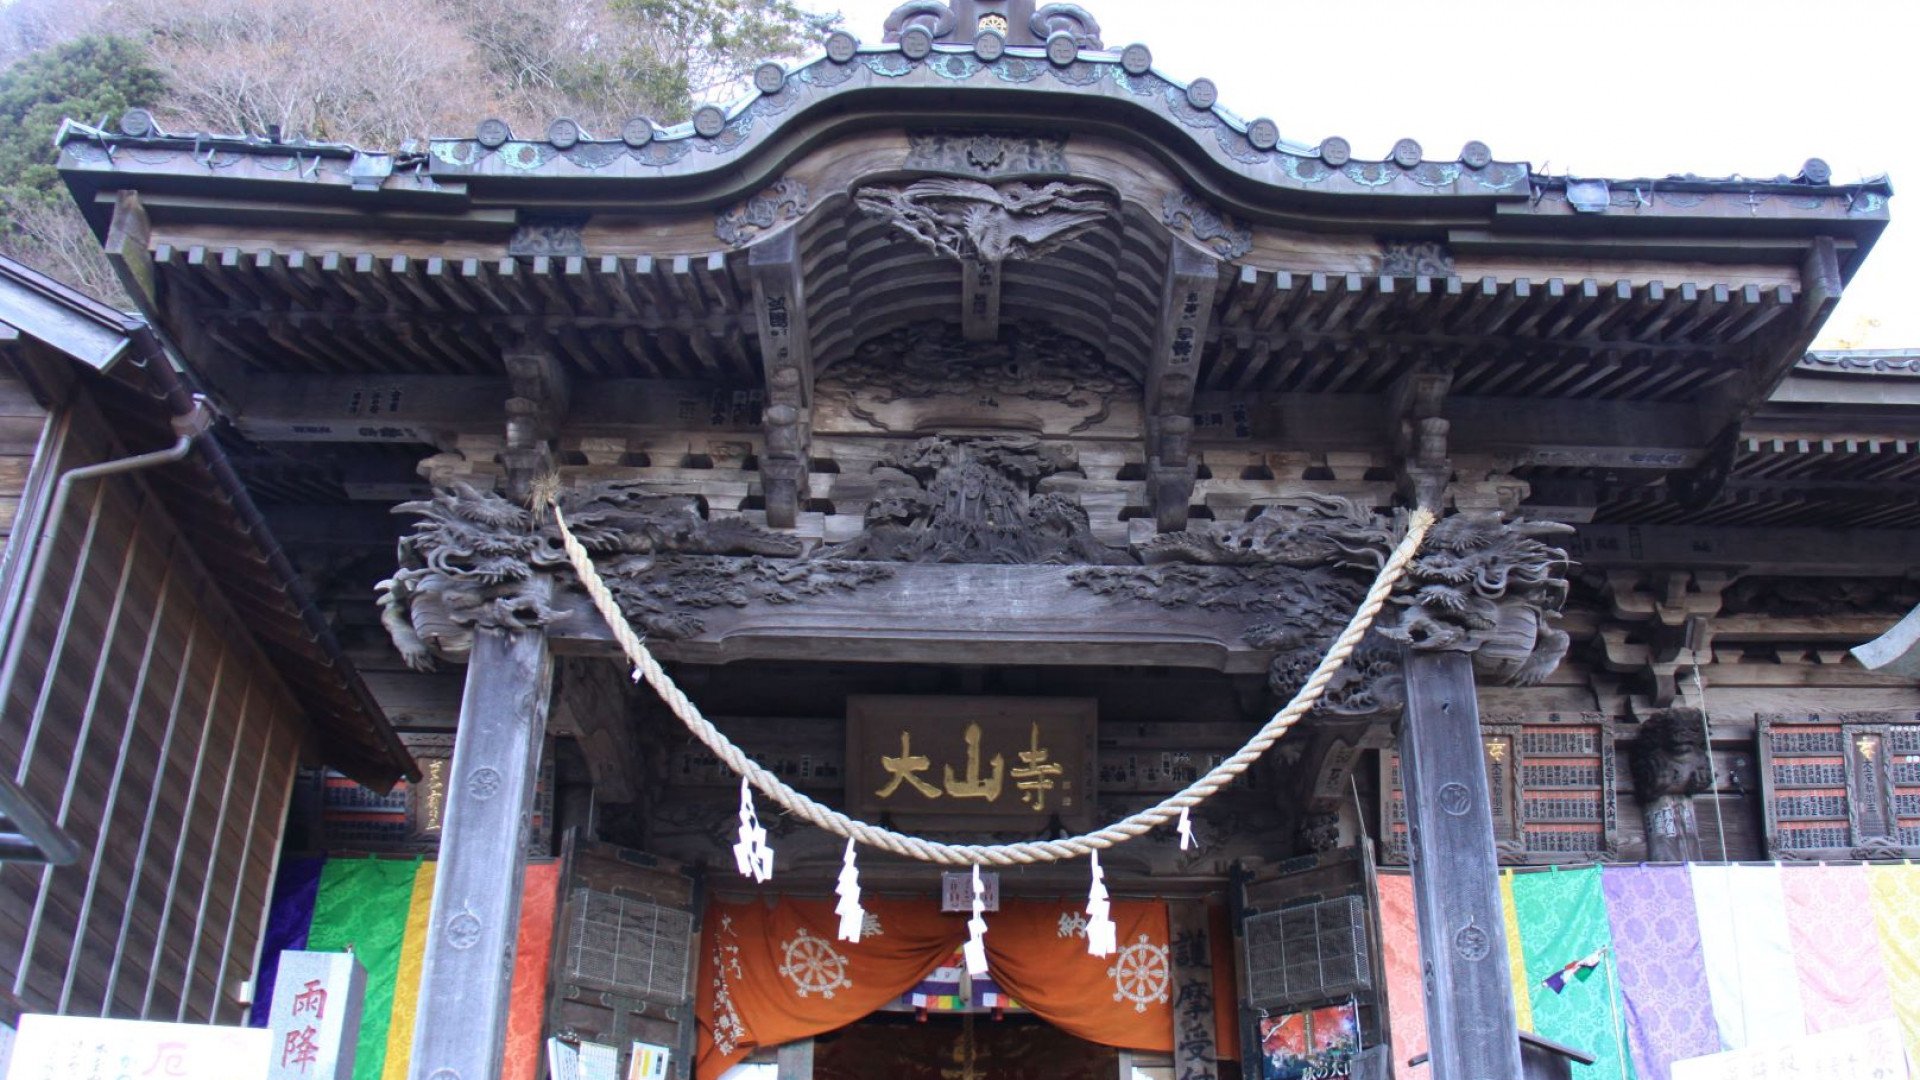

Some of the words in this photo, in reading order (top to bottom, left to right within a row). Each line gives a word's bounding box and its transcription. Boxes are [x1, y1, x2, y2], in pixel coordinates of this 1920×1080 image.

[875, 719, 1064, 811] 大山寺
[281, 978, 329, 1074] 雨降
